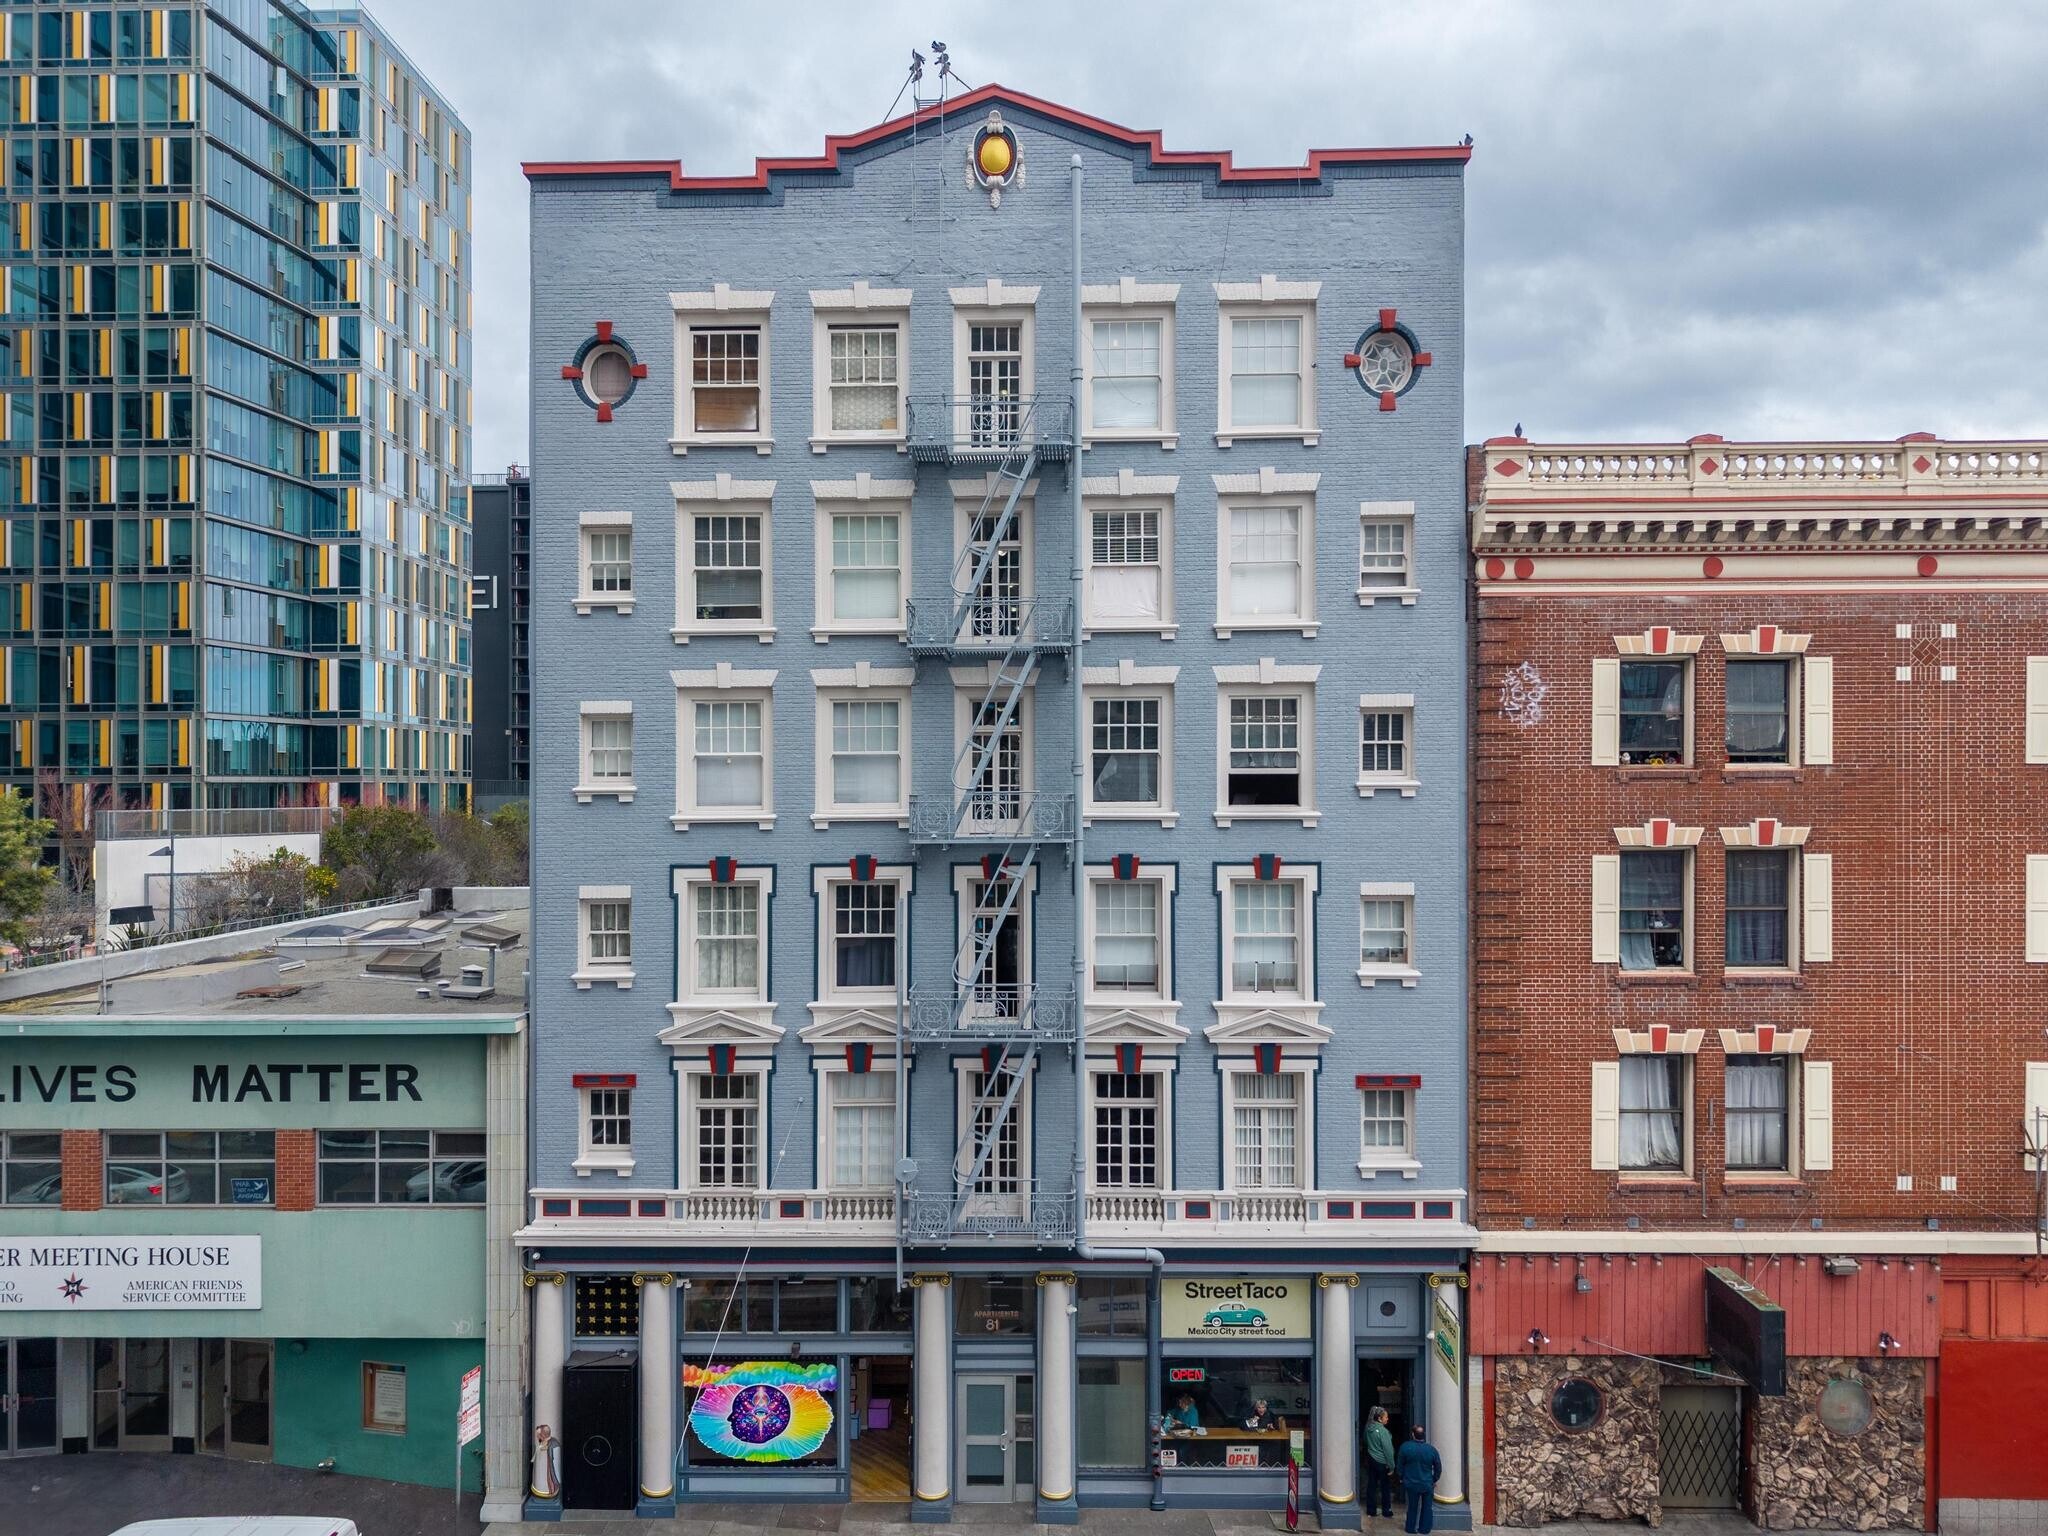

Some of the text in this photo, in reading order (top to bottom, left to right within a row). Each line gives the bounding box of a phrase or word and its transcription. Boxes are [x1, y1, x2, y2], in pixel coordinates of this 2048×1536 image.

[0, 1064, 423, 1102] IVES MATTER
[29, 1247, 138, 1266] MEETING
[147, 1247, 230, 1266] HOUSE
[127, 1280, 188, 1290] AMERICAN
[192, 1280, 243, 1290] FRIENDS
[122, 1292, 171, 1303] SERVICE
[174, 1292, 247, 1302] COMMITTEE
[985, 1318, 999, 1331] 81
[1187, 1327, 1286, 1337] Mexico City street food
[1172, 1369, 1203, 1381] OPEN
[1228, 1453, 1257, 1466] OPEN
